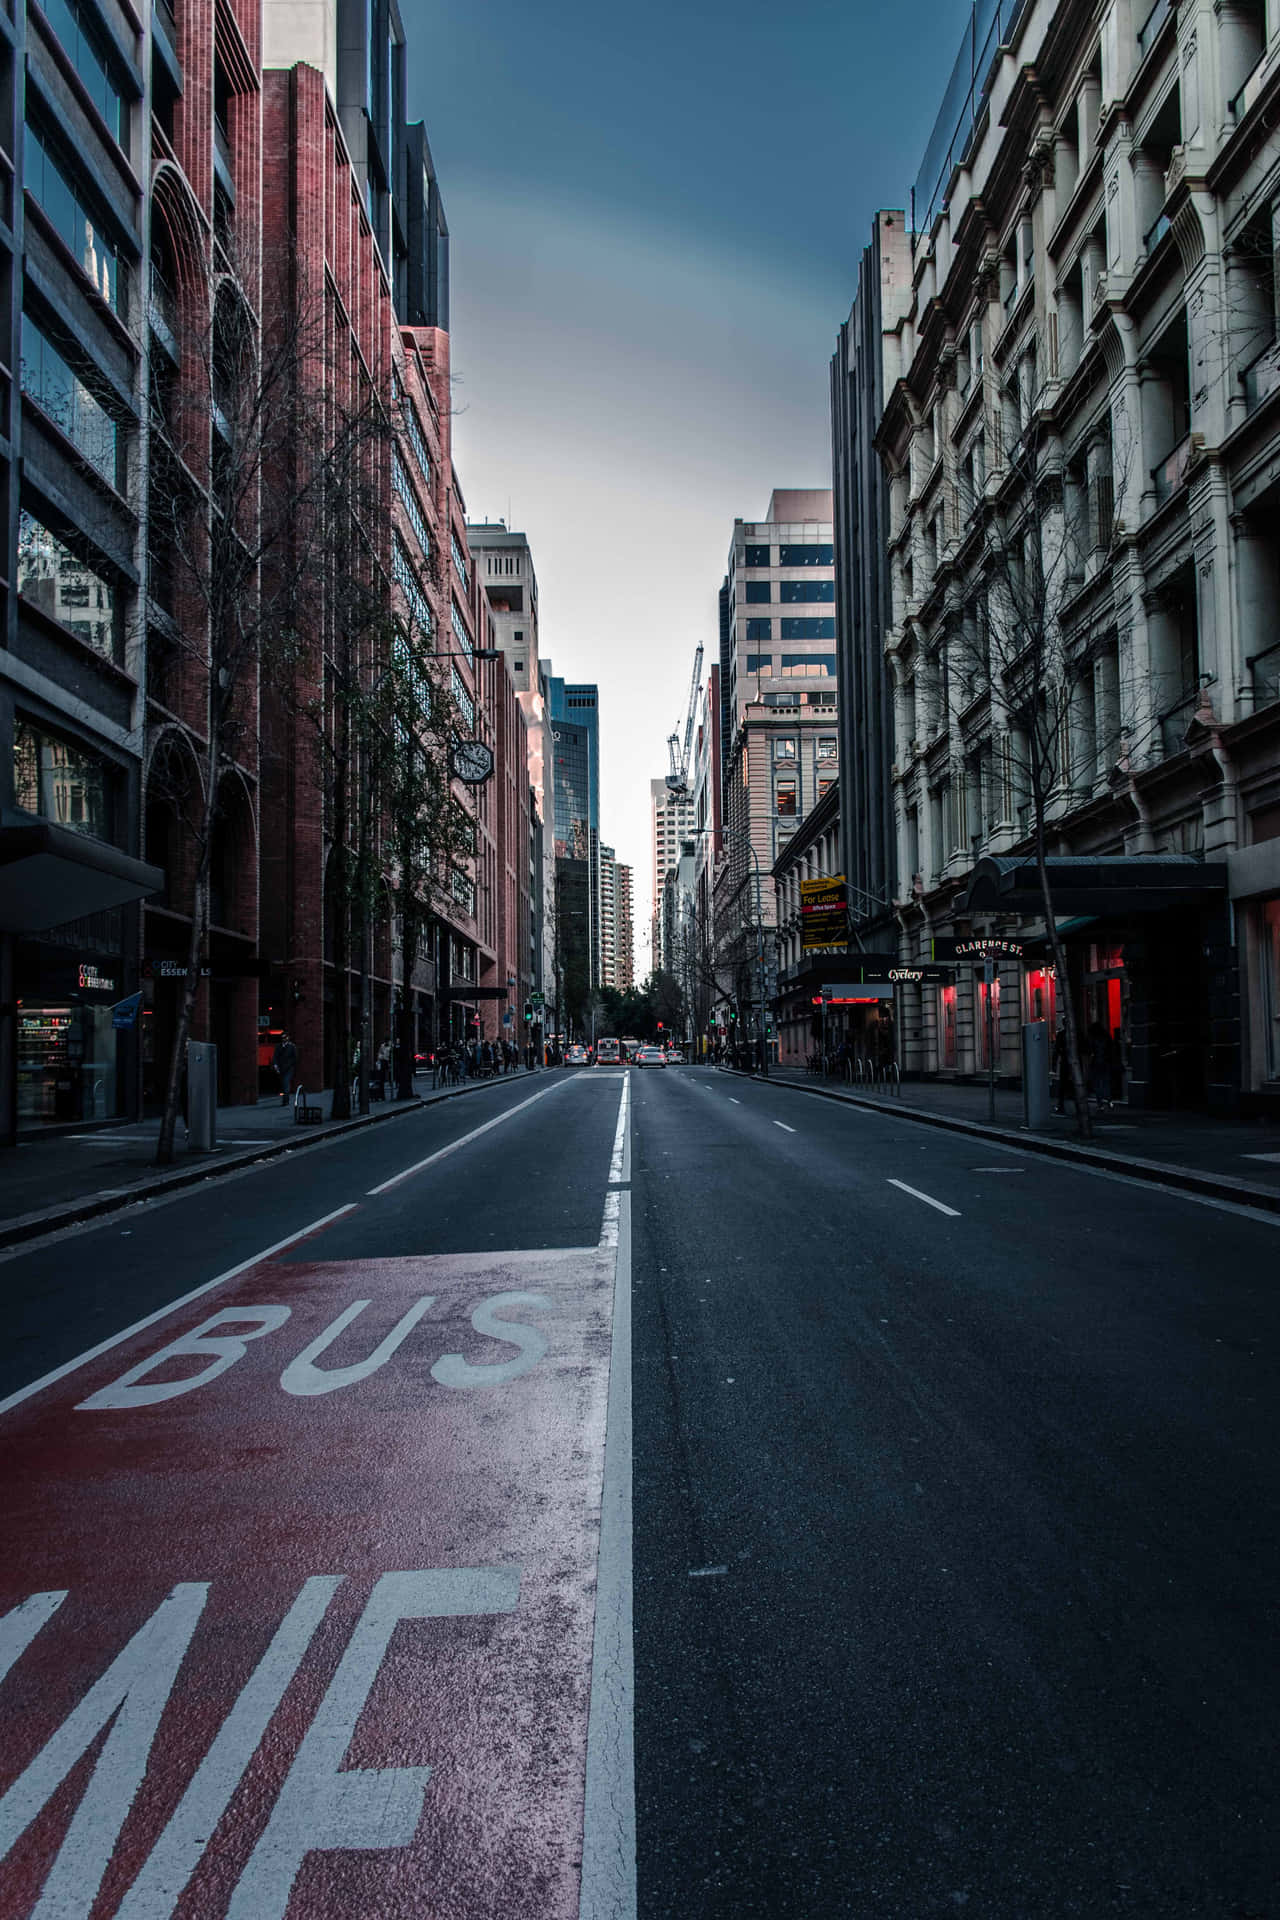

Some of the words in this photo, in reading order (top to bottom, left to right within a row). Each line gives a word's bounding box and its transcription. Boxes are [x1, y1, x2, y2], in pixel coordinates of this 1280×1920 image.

[803, 896, 815, 904] For
[817, 893, 840, 903] Lease
[955, 939, 1008, 954] CLARENCE
[160, 960, 177, 969] CITY
[160, 968, 212, 977] ESSENLS
[887, 968, 924, 982] Cyclery
[73, 1291, 551, 1411] BUS
